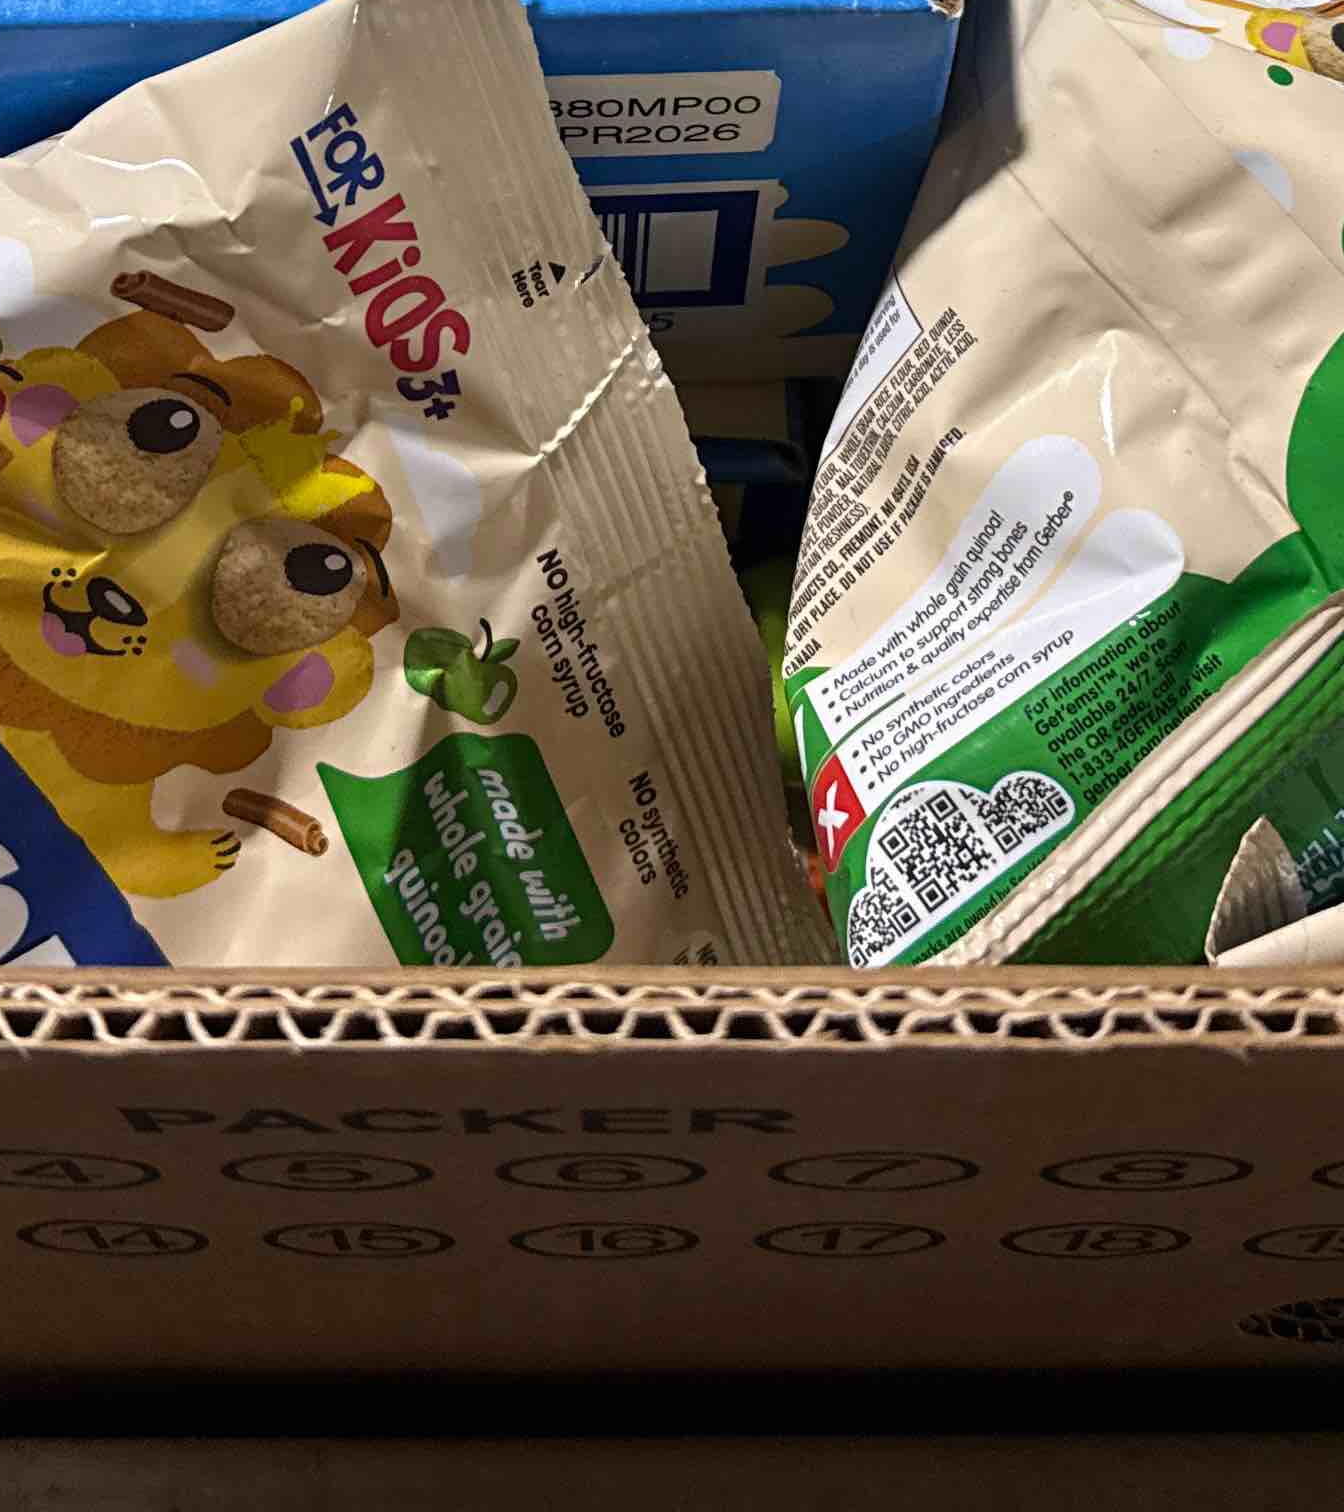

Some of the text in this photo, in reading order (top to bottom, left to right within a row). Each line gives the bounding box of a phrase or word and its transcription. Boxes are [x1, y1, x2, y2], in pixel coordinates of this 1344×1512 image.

[306, 102, 385, 206] FOR
[511, 270, 534, 308] Here
[528, 261, 550, 298] Tear
[396, 369, 462, 420] 3+
[537, 548, 625, 739] NO high-fructose
[833, 508, 1005, 689] Made with whole grain quinoa!
[839, 520, 1029, 701] Calcium to support strong bones
[845, 672, 905, 717] Nutrition
[906, 662, 920, 675] &
[920, 627, 966, 666] quality
[967, 574, 1022, 631] expertise
[1013, 546, 1043, 578] from
[531, 603, 589, 720] corn syrup
[861, 649, 997, 752] No synthetic colors
[868, 653, 1016, 767] No GMO ingredients
[876, 628, 1075, 783] No high-fructose corn syrup
[423, 769, 487, 879] whole
[476, 768, 582, 941] made with
[619, 818, 657, 886] colors
[629, 771, 690, 900] NO synthetic
[120, 1106, 796, 1137] PACKER
[59, 1222, 168, 1253] 14
[311, 1223, 420, 1255] 15
[560, 1226, 665, 1255] 16
[803, 1225, 909, 1253] 17
[1049, 1226, 1157, 1255] 18
